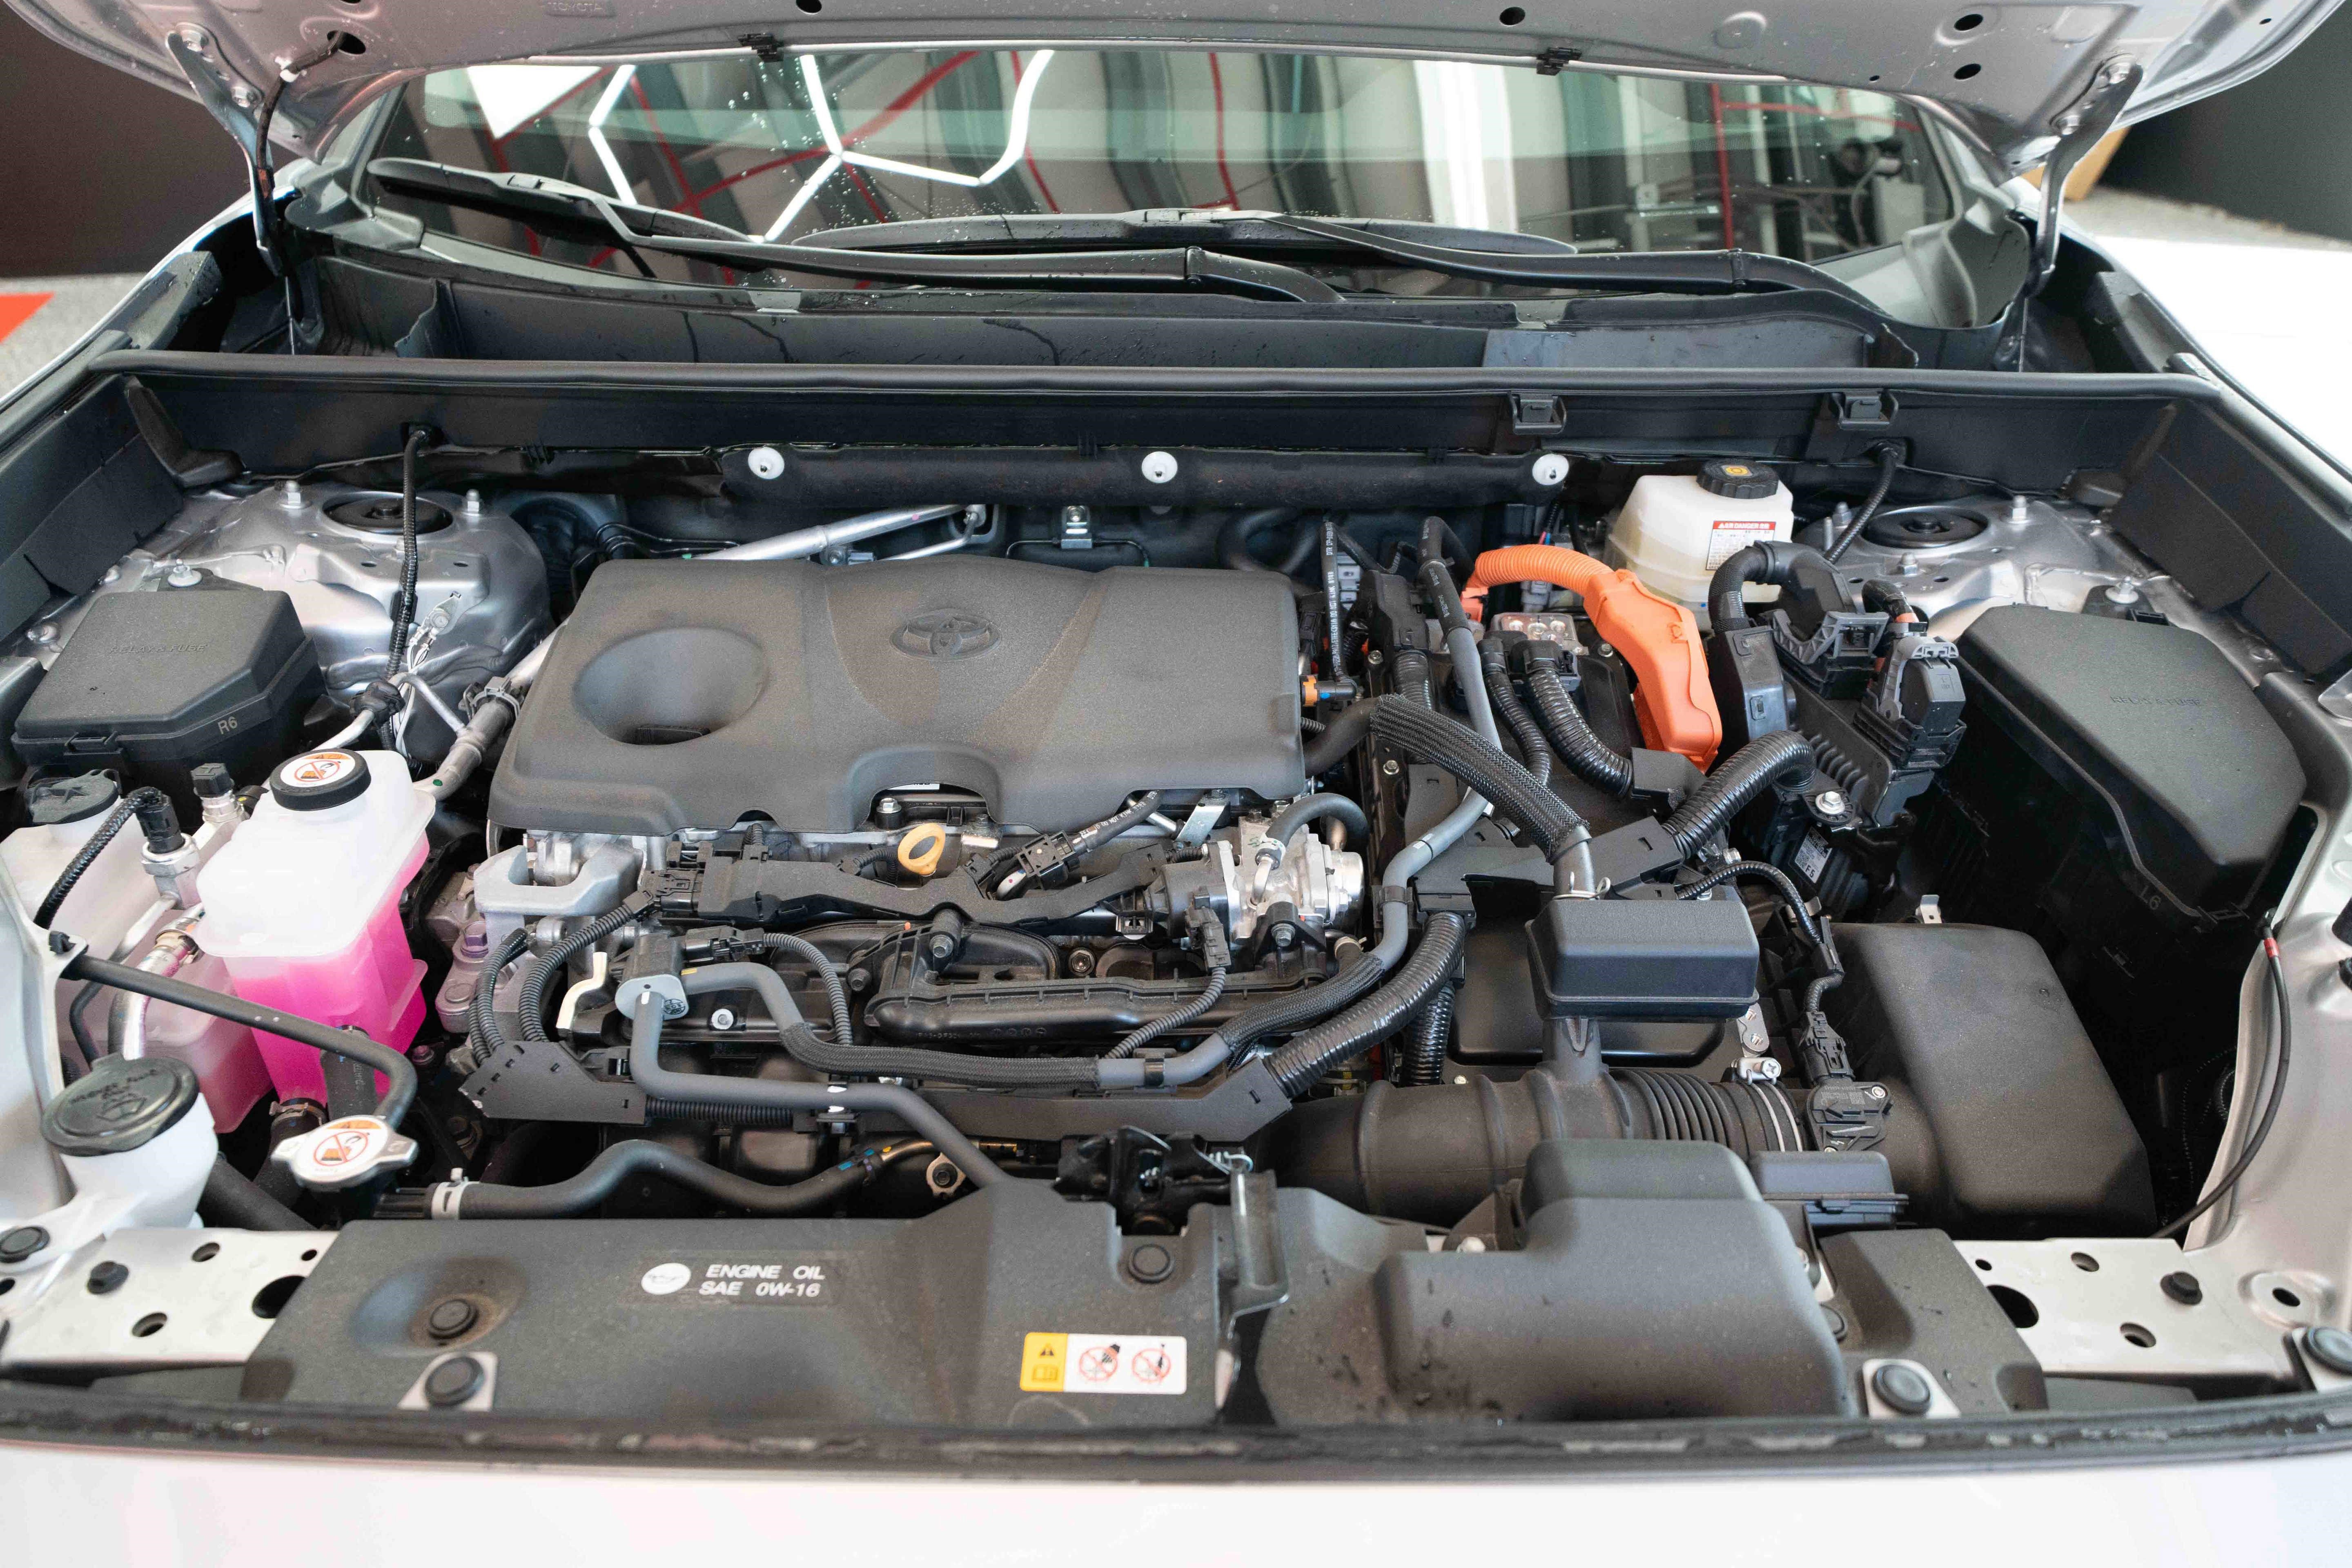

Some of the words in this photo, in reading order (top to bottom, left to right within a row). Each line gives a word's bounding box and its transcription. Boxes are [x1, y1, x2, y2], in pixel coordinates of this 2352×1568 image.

[218, 716, 238, 734] R6
[705, 1263, 782, 1279] ENGINE
[792, 1265, 826, 1280] OIL
[698, 1281, 744, 1296] SAE
[755, 1282, 821, 1298] 0W-16
